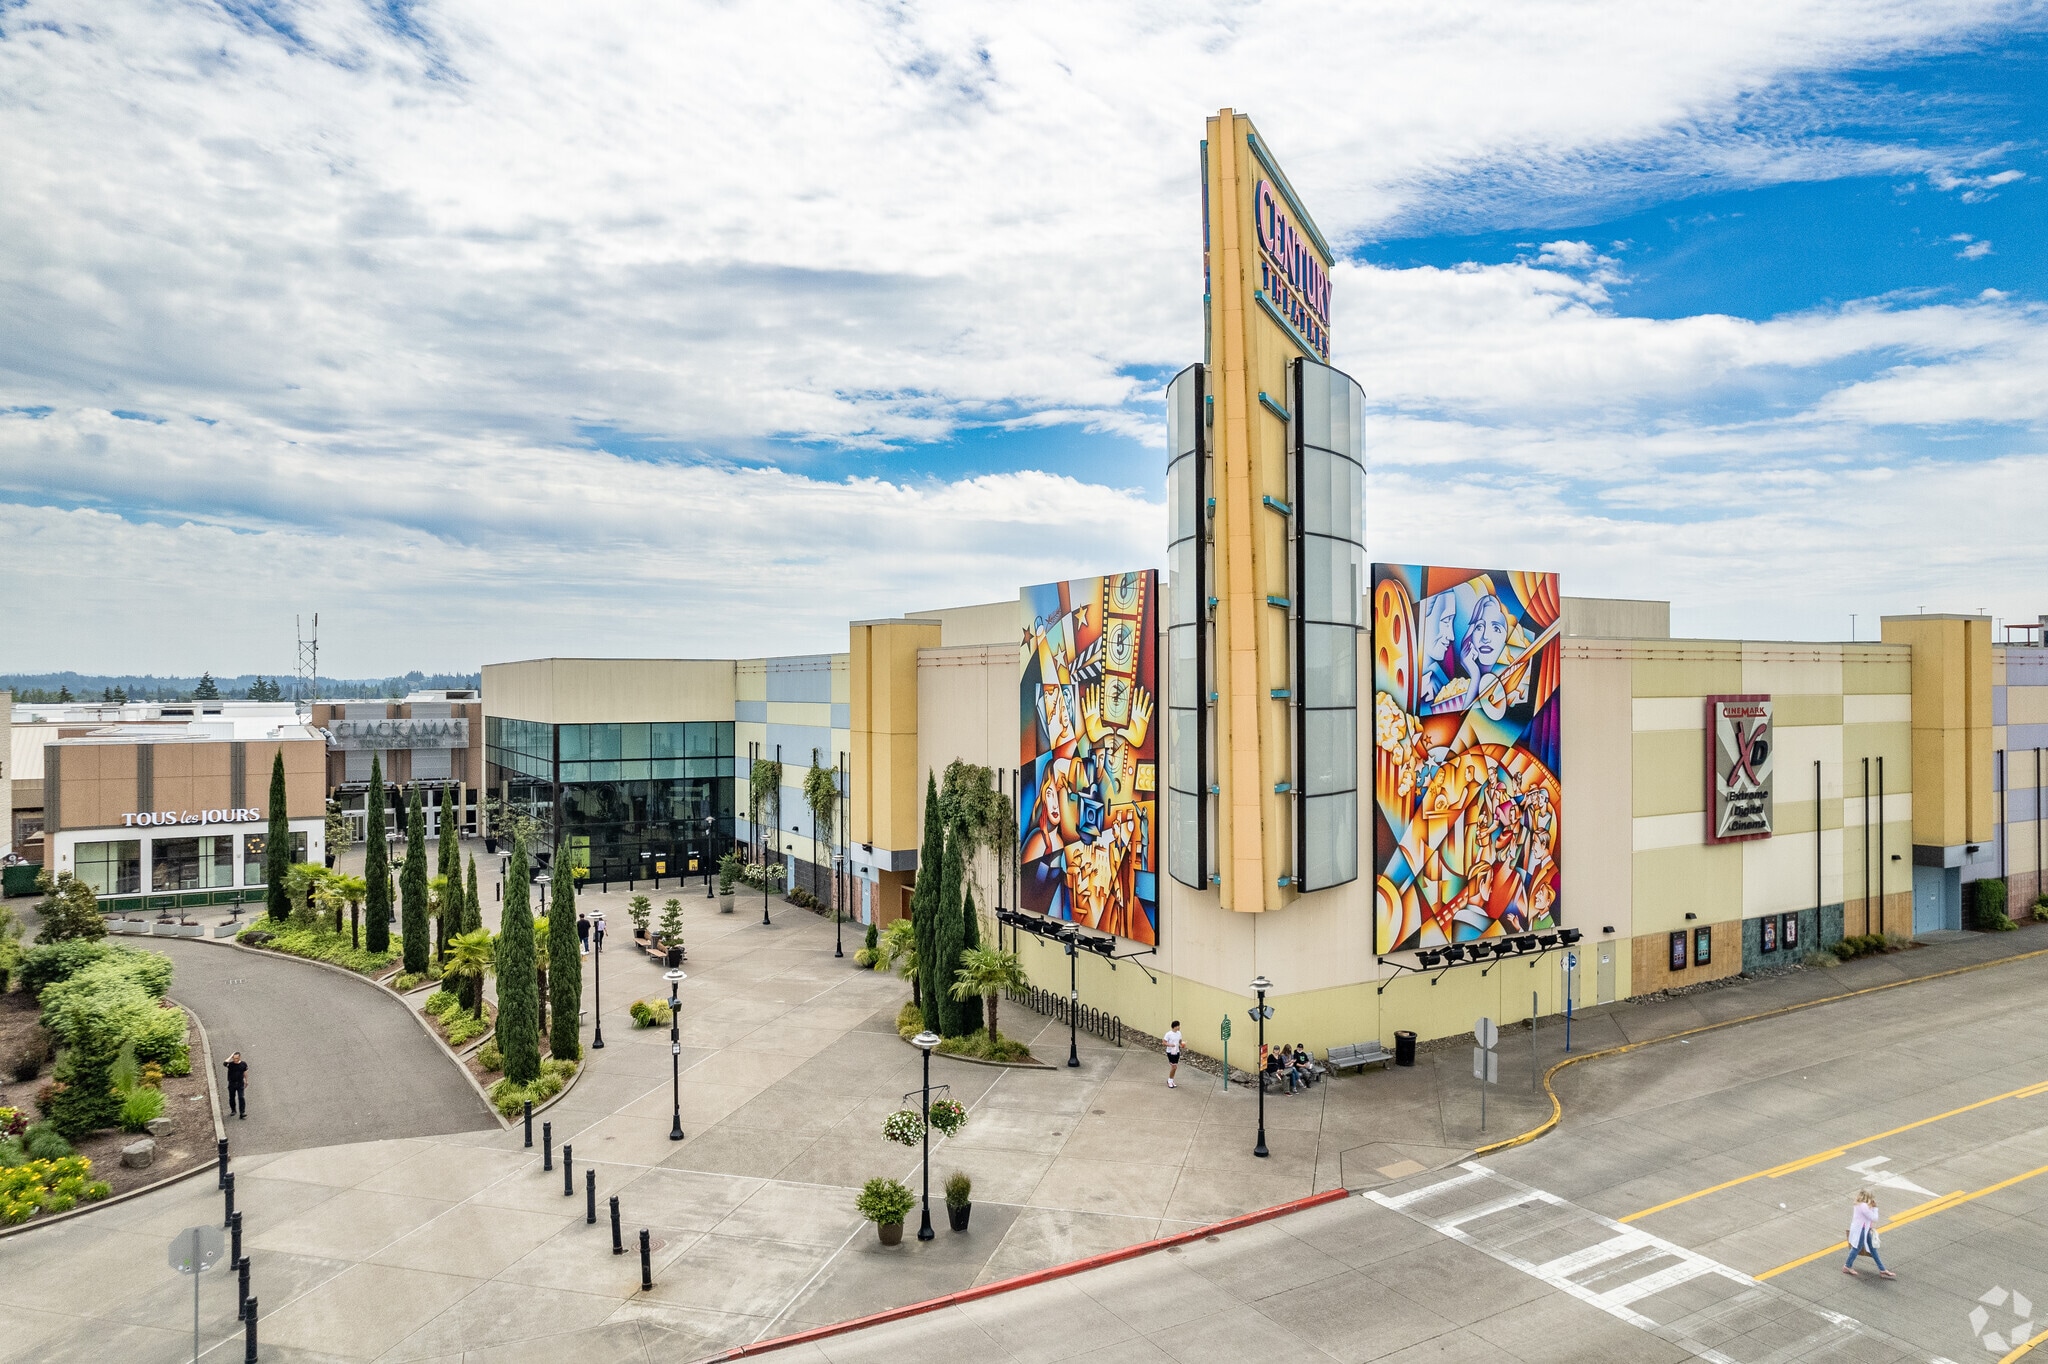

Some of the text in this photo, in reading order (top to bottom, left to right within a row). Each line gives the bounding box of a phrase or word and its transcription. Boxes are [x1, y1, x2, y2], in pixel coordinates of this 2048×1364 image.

[1255, 180, 1333, 327] CENTURY
[1262, 262, 1330, 358] THEATRES
[1723, 706, 1767, 718] CINEMARK
[336, 721, 462, 738] CLACKAMAS
[359, 738, 440, 749] TOWN CENTER
[1727, 721, 1769, 787] XD
[1728, 789, 1768, 802] Extreme
[121, 807, 261, 827] TOUS les JOURS
[1733, 804, 1764, 818] Digital
[1730, 819, 1767, 832] Cinema
